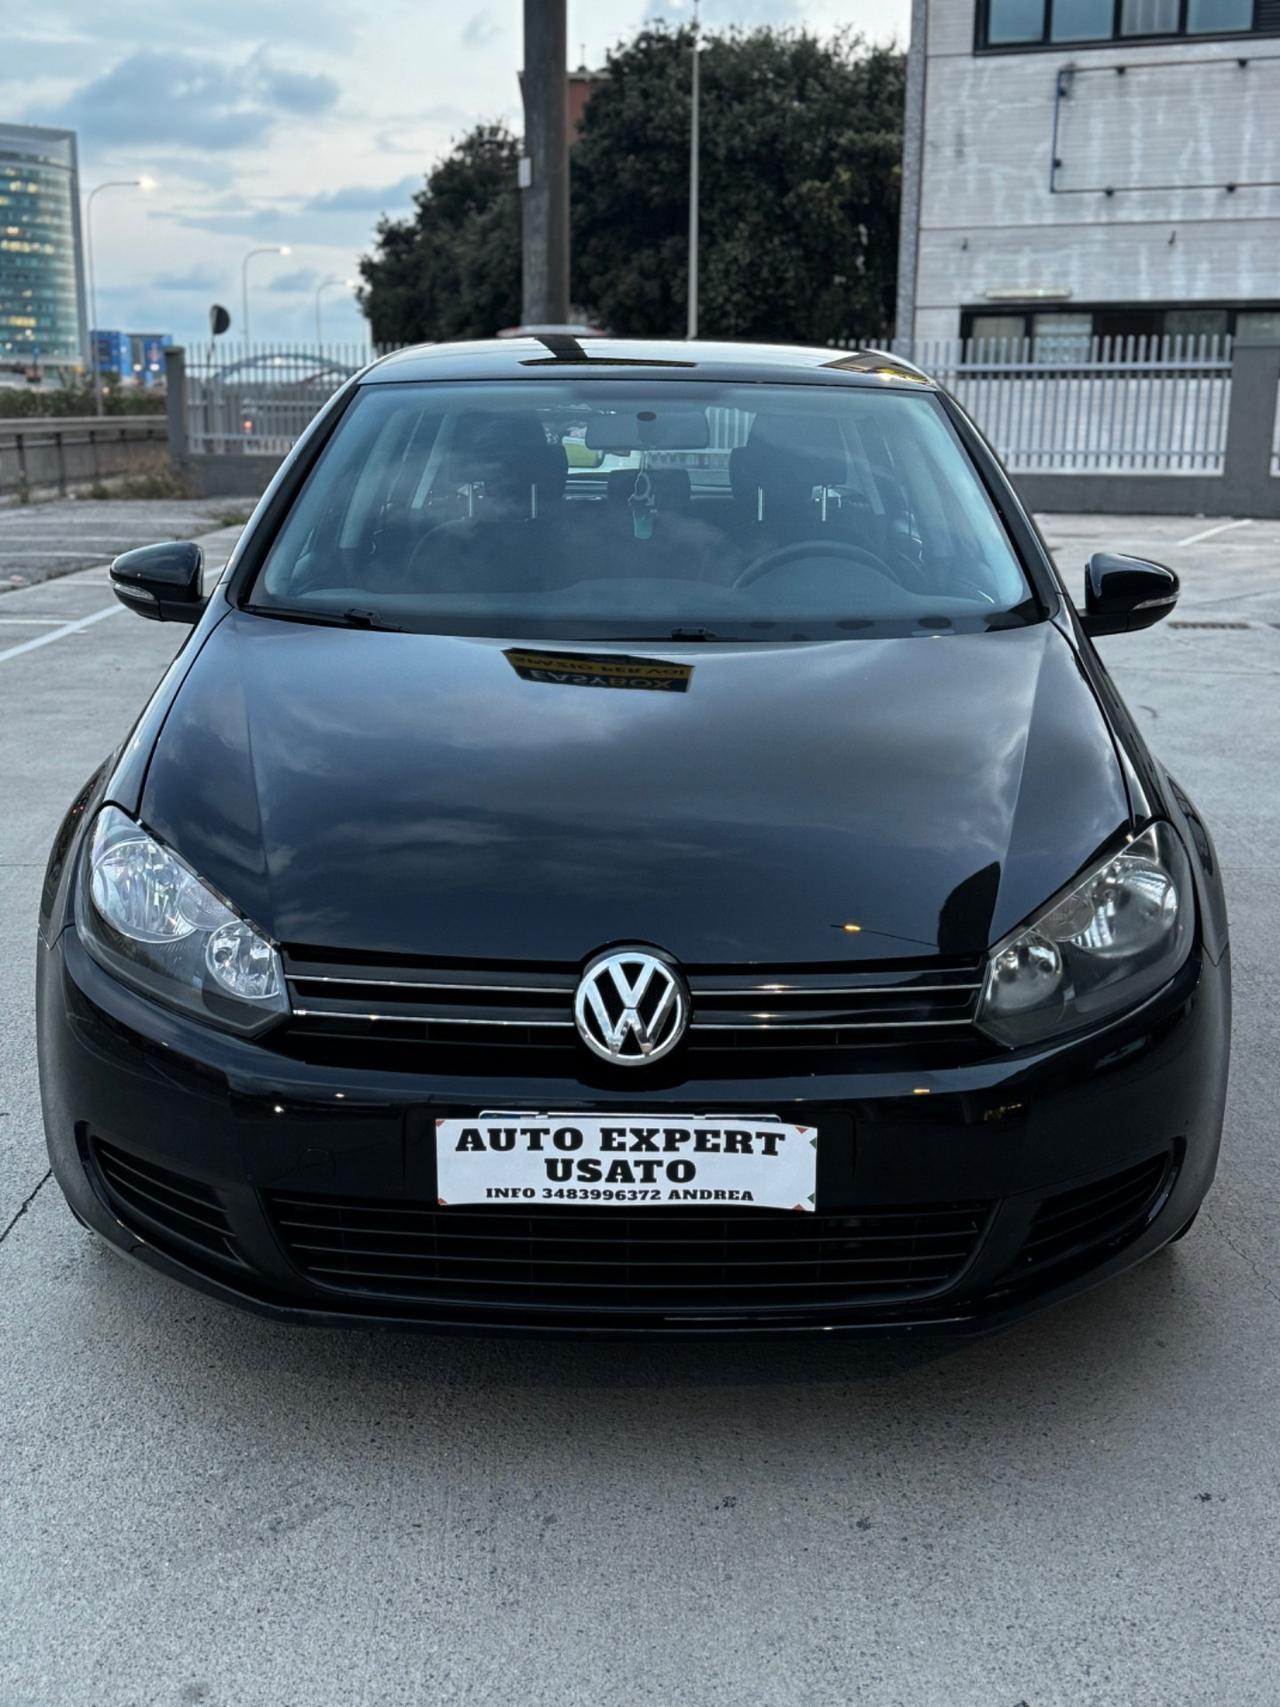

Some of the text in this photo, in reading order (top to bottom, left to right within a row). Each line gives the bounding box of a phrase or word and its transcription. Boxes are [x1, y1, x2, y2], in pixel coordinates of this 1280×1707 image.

[579, 954, 683, 1062] VW
[455, 1127, 786, 1156] AUTO EXPERT
[544, 1158, 697, 1183] USATO
[486, 1187, 754, 1202] INFO 3483996372 ANDREA
